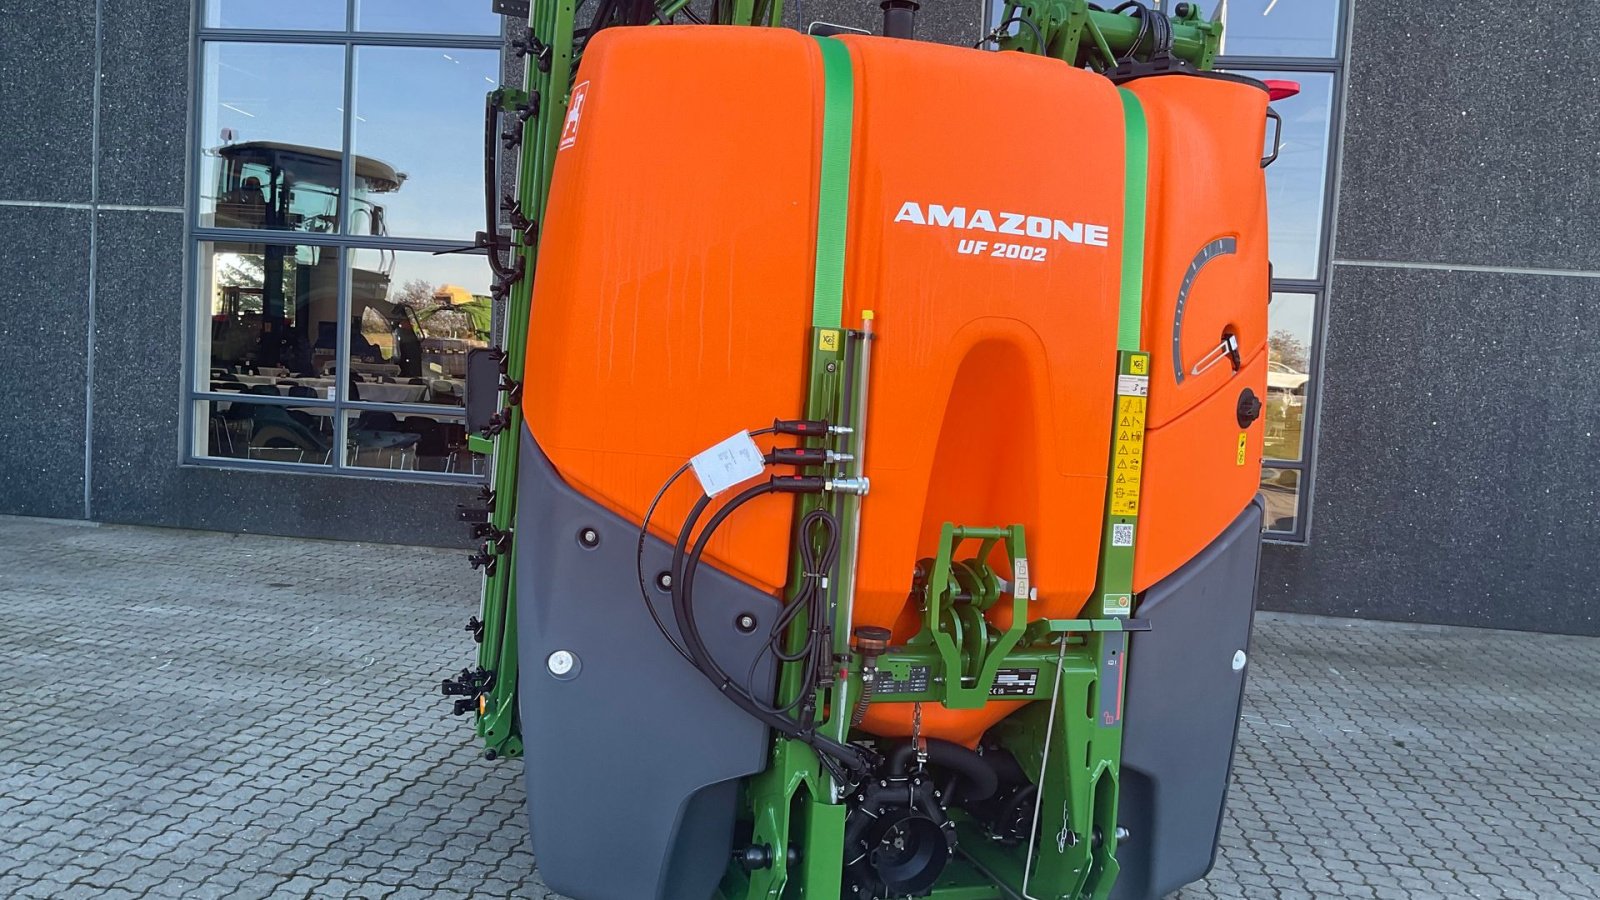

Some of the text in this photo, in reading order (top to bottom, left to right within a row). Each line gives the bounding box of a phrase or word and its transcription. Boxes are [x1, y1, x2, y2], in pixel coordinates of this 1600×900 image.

[894, 201, 1109, 247] AMAZONE
[958, 239, 1047, 262] UF 2002
